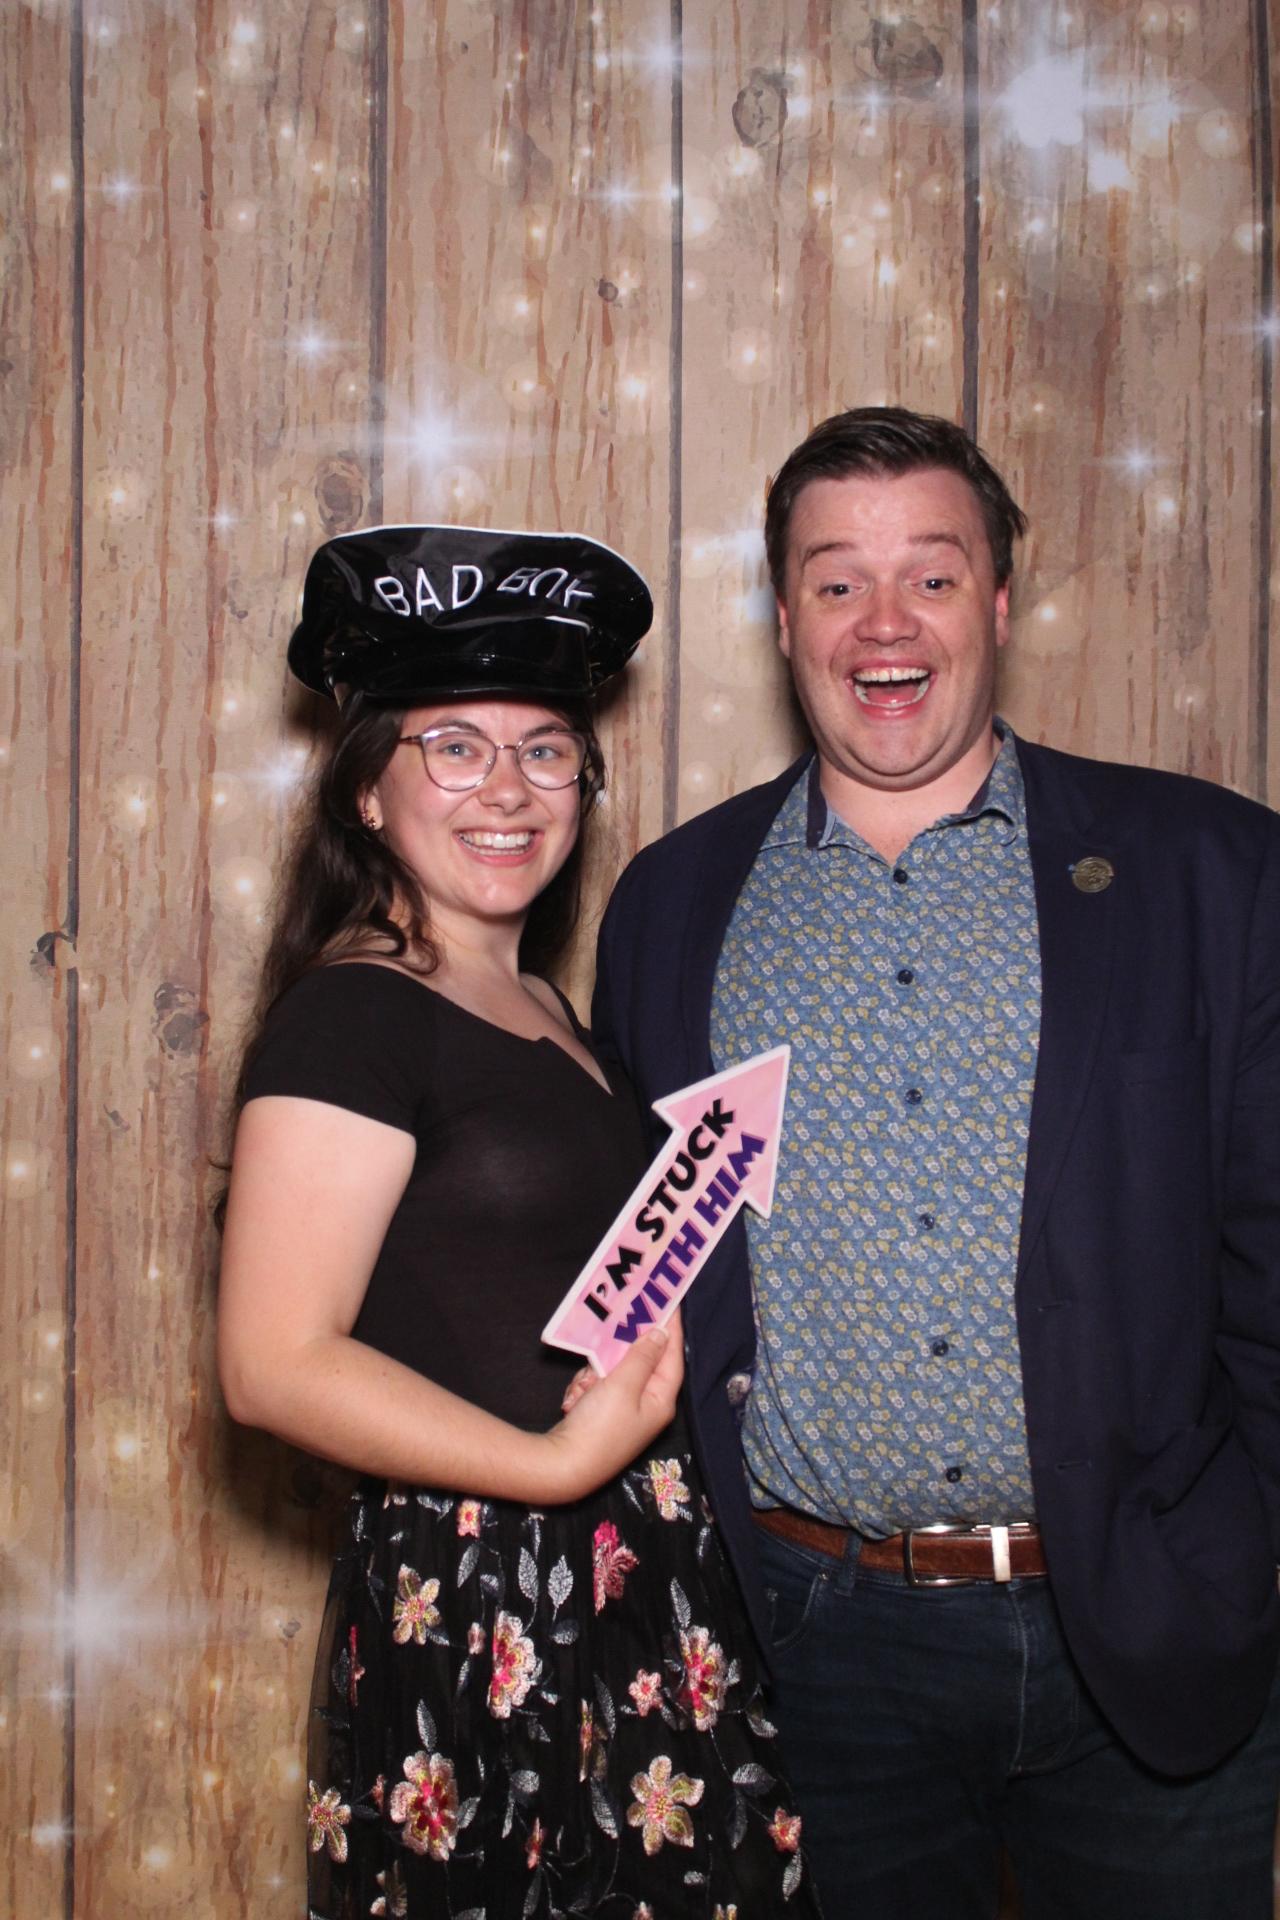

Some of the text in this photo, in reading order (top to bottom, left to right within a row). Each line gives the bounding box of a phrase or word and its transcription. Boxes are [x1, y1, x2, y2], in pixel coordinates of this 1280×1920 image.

[374, 565, 484, 616] BAD
[584, 1098, 734, 1322] I'M STUCK
[613, 1132, 766, 1343] WITH HIM
